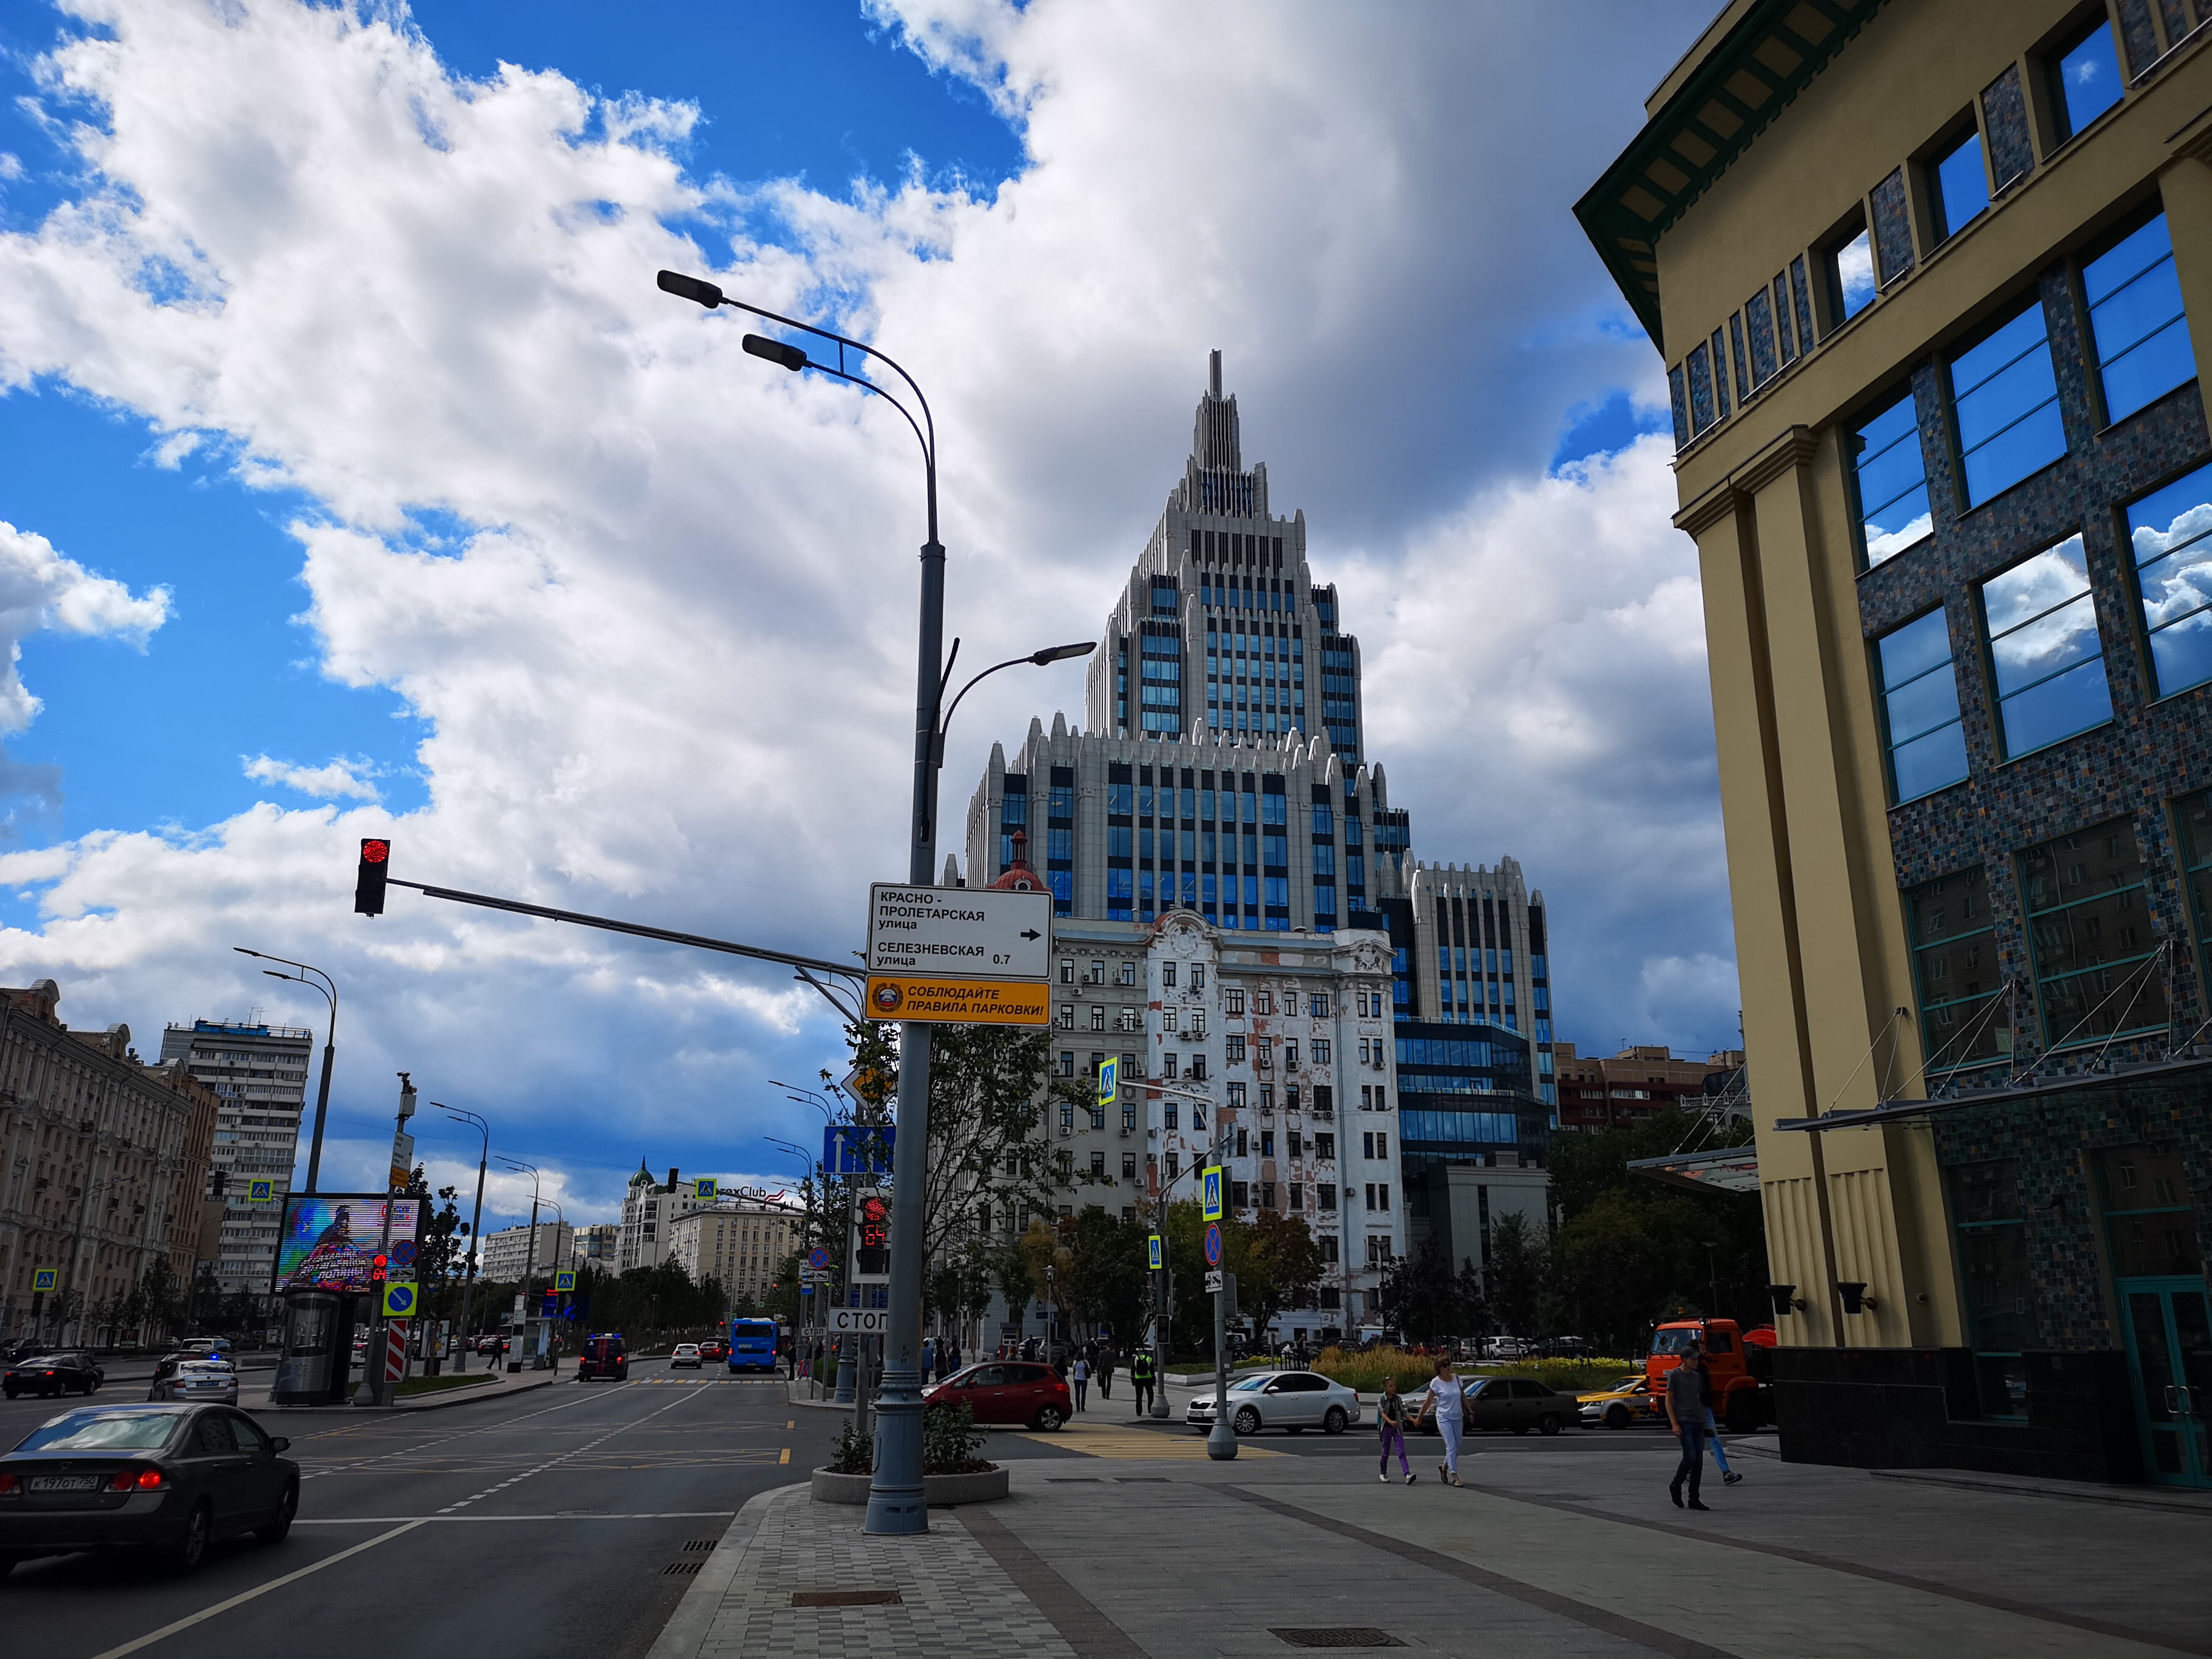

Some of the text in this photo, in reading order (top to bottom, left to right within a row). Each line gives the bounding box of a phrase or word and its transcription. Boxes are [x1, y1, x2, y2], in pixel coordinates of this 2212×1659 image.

[880, 892, 933, 904] КРАСНО
[880, 907, 985, 921] ПРОЛЕТАРСКАЯ
[879, 919, 917, 930] улица
[878, 942, 984, 956] СЕЛЕЗНЕВСКАЯ
[877, 954, 1010, 967] улица 0.7
[908, 987, 1000, 1000] СОБЛЮДАЙТЕ
[907, 1000, 1044, 1015] ПРАВИЛА ПАРКОВКИ!
[866, 1225, 885, 1245] 64
[373, 1269, 386, 1280] 64
[837, 1312, 888, 1329] СТОП
[34, 1478, 76, 1488] К197ОТ
